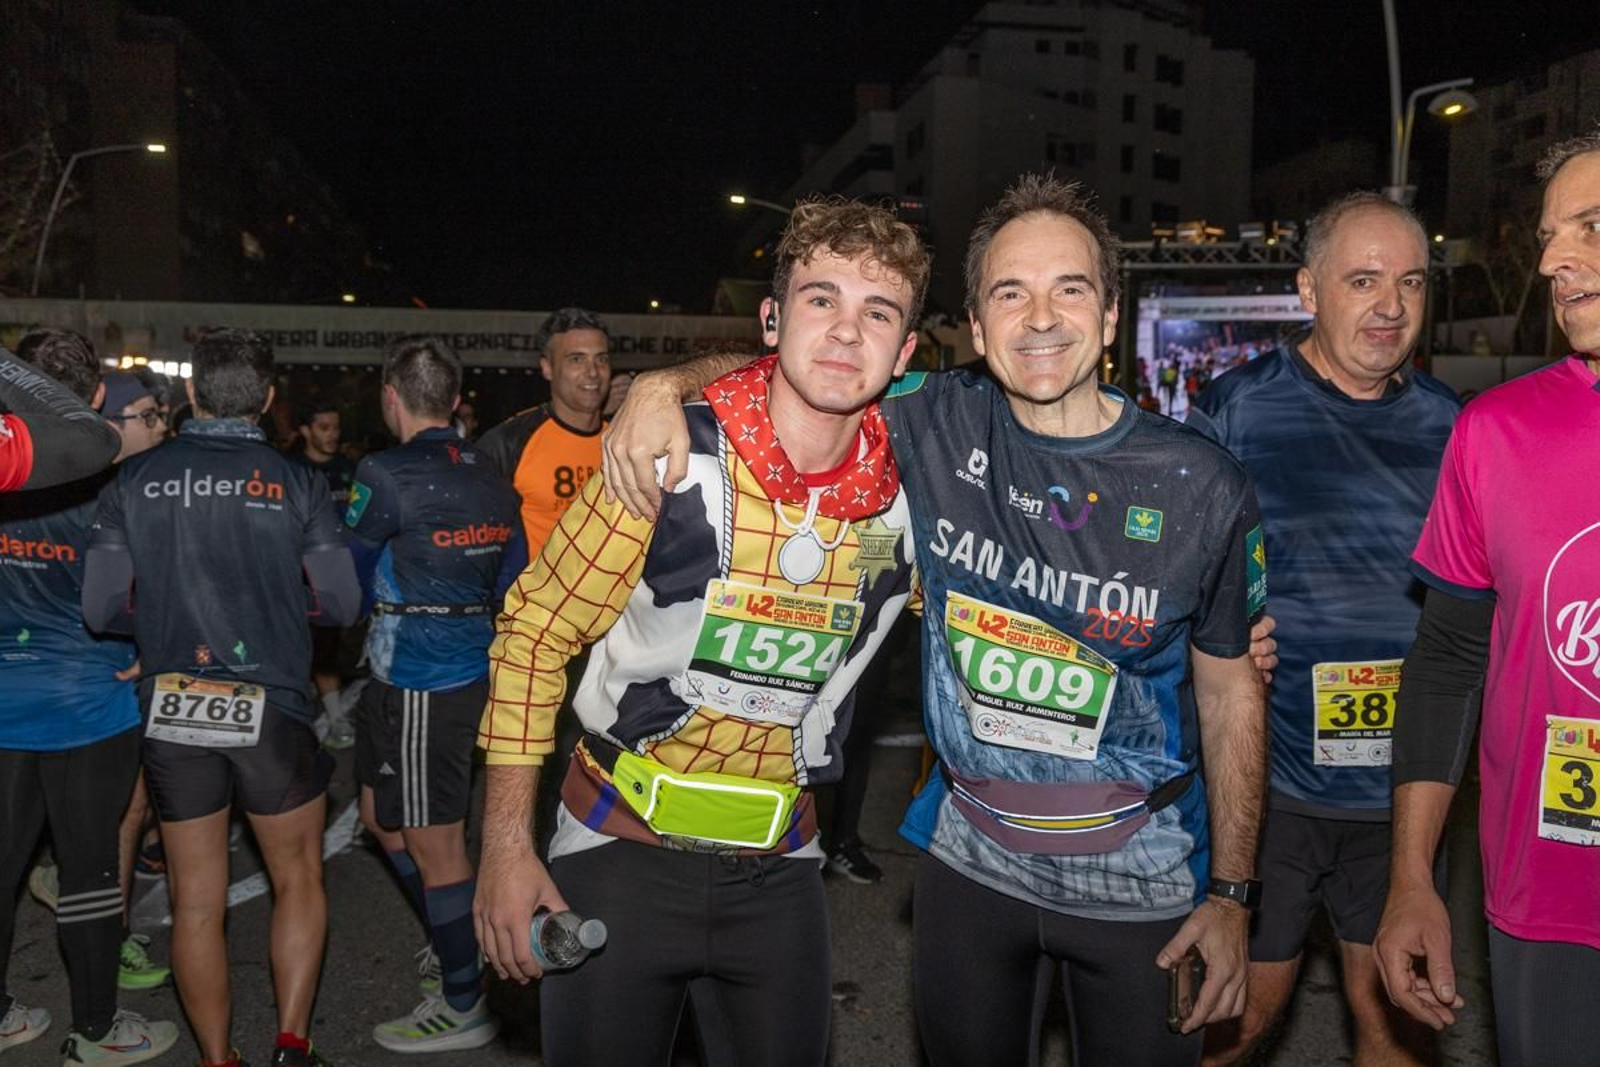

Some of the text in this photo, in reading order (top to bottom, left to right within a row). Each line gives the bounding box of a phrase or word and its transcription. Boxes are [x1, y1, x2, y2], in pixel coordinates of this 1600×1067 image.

[143, 468, 284, 508] calderón
[554, 465, 576, 498] 8
[928, 517, 1160, 628] SAN ANTÓN
[745, 593, 775, 619] 42
[773, 608, 793, 619] SAN
[976, 609, 1009, 639] 42
[1005, 630, 1030, 645] SAN
[1080, 607, 1157, 648] 2025
[713, 621, 846, 679] 1524
[729, 670, 766, 684] FERNANDO
[767, 677, 784, 687] RUIZ
[954, 636, 1096, 710] 1609
[1347, 667, 1375, 685] 42
[159, 692, 254, 724] 8768
[976, 694, 1077, 723] MIGUEL RUIZ ARMENTEROS
[1328, 692, 1398, 728] 38
